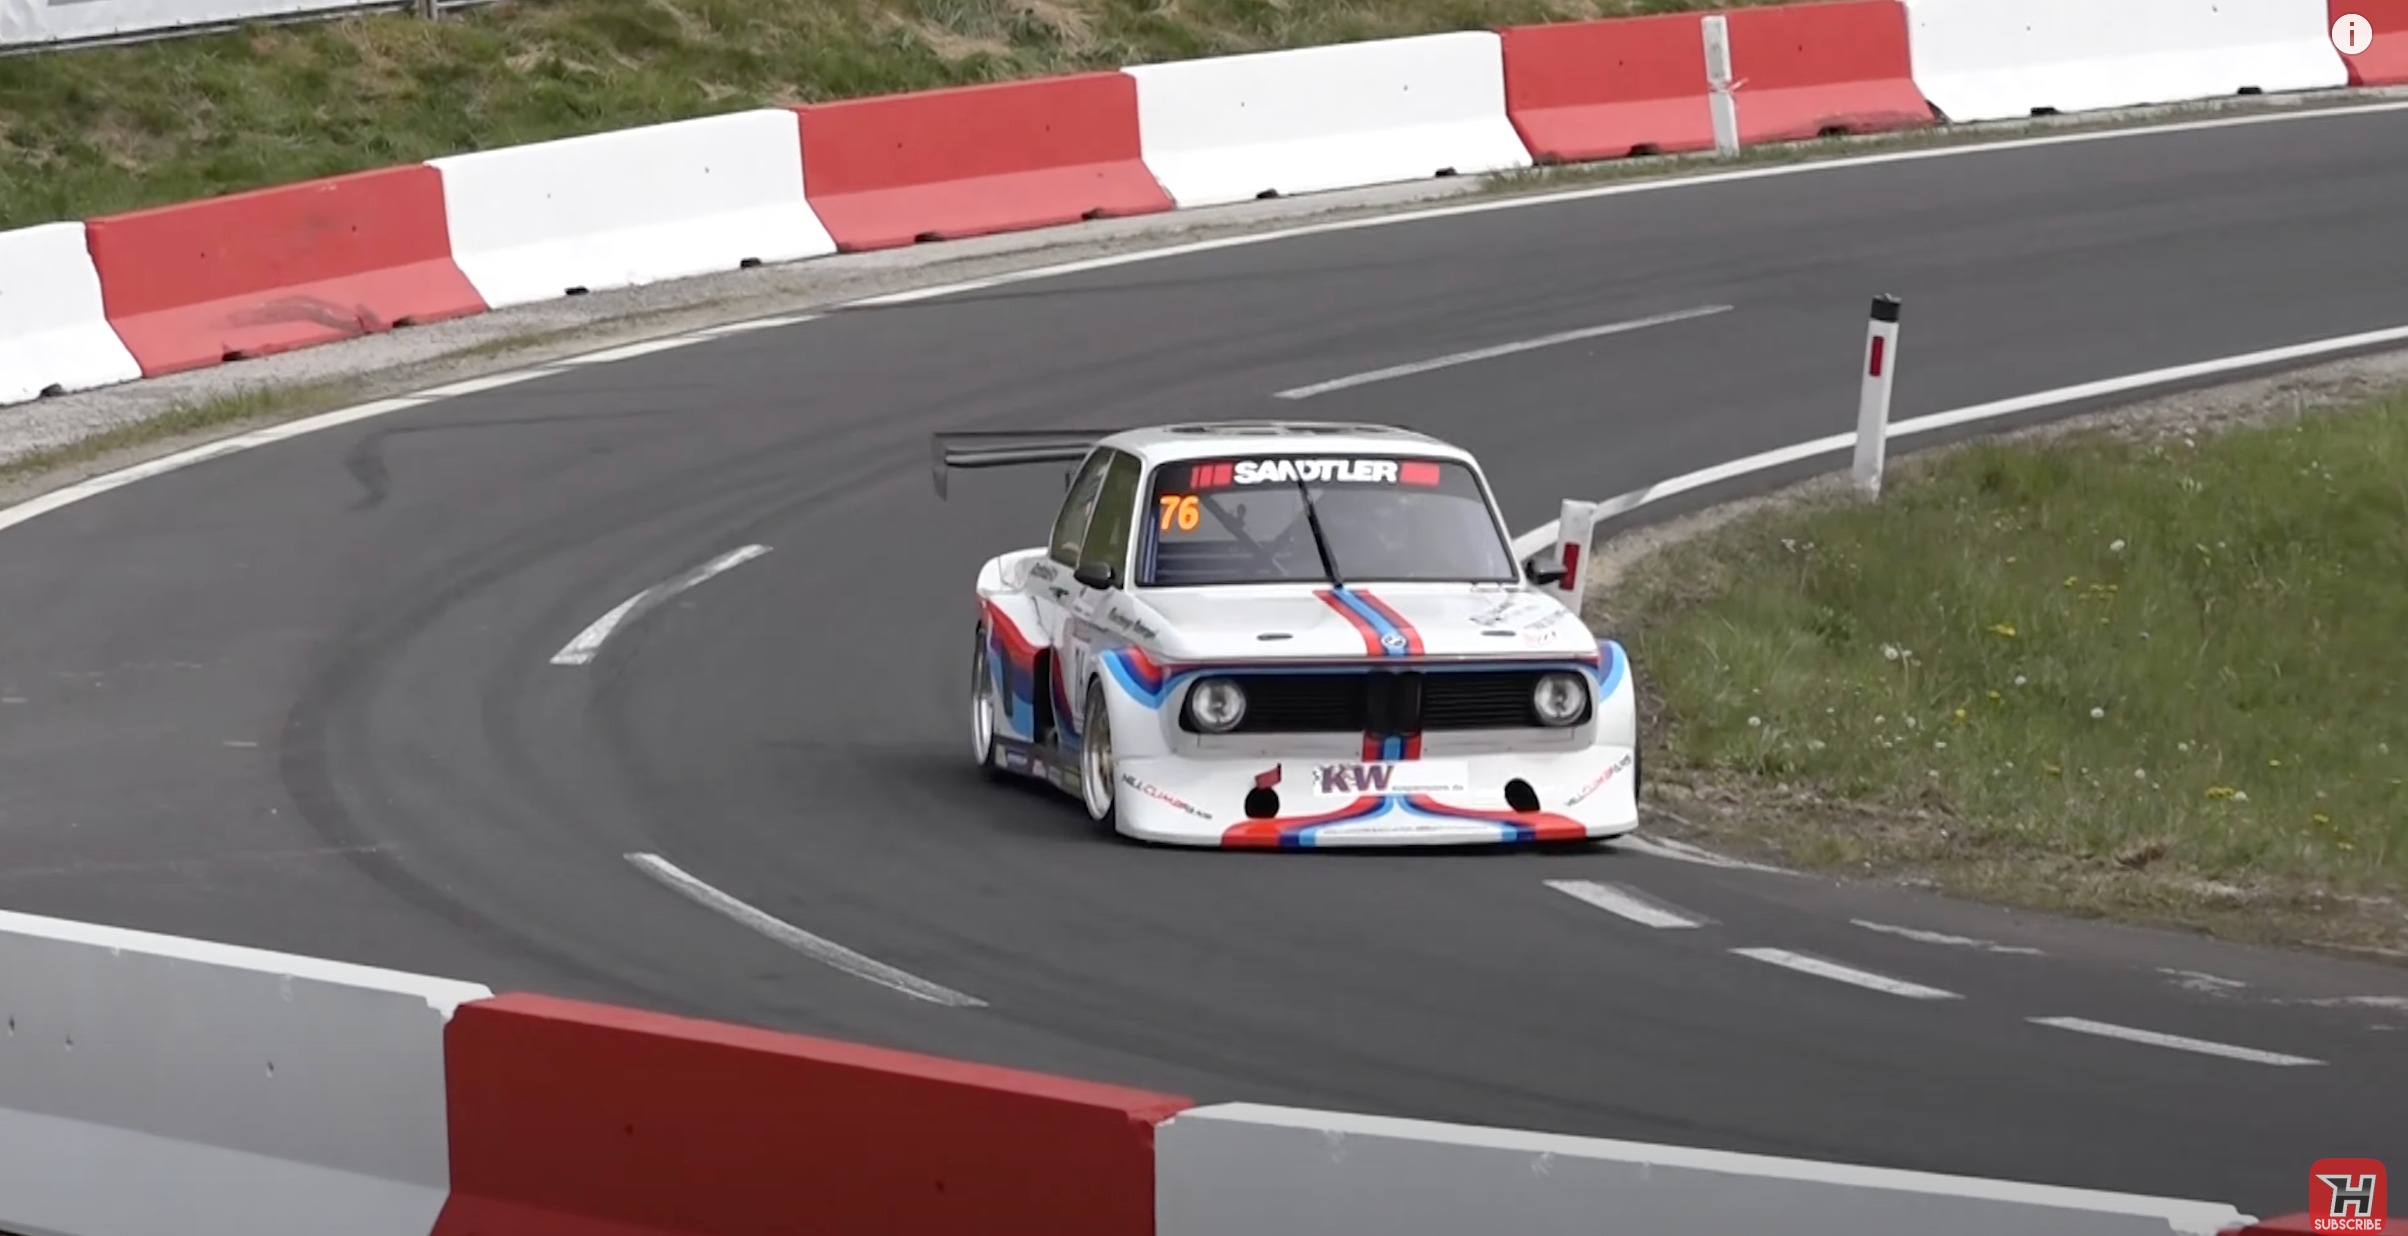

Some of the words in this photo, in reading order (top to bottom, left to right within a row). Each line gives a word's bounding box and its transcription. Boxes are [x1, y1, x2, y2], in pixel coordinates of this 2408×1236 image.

[1233, 459, 1398, 485] SANDTLER
[1159, 495, 1200, 531] 76
[1320, 764, 1394, 793] KW
